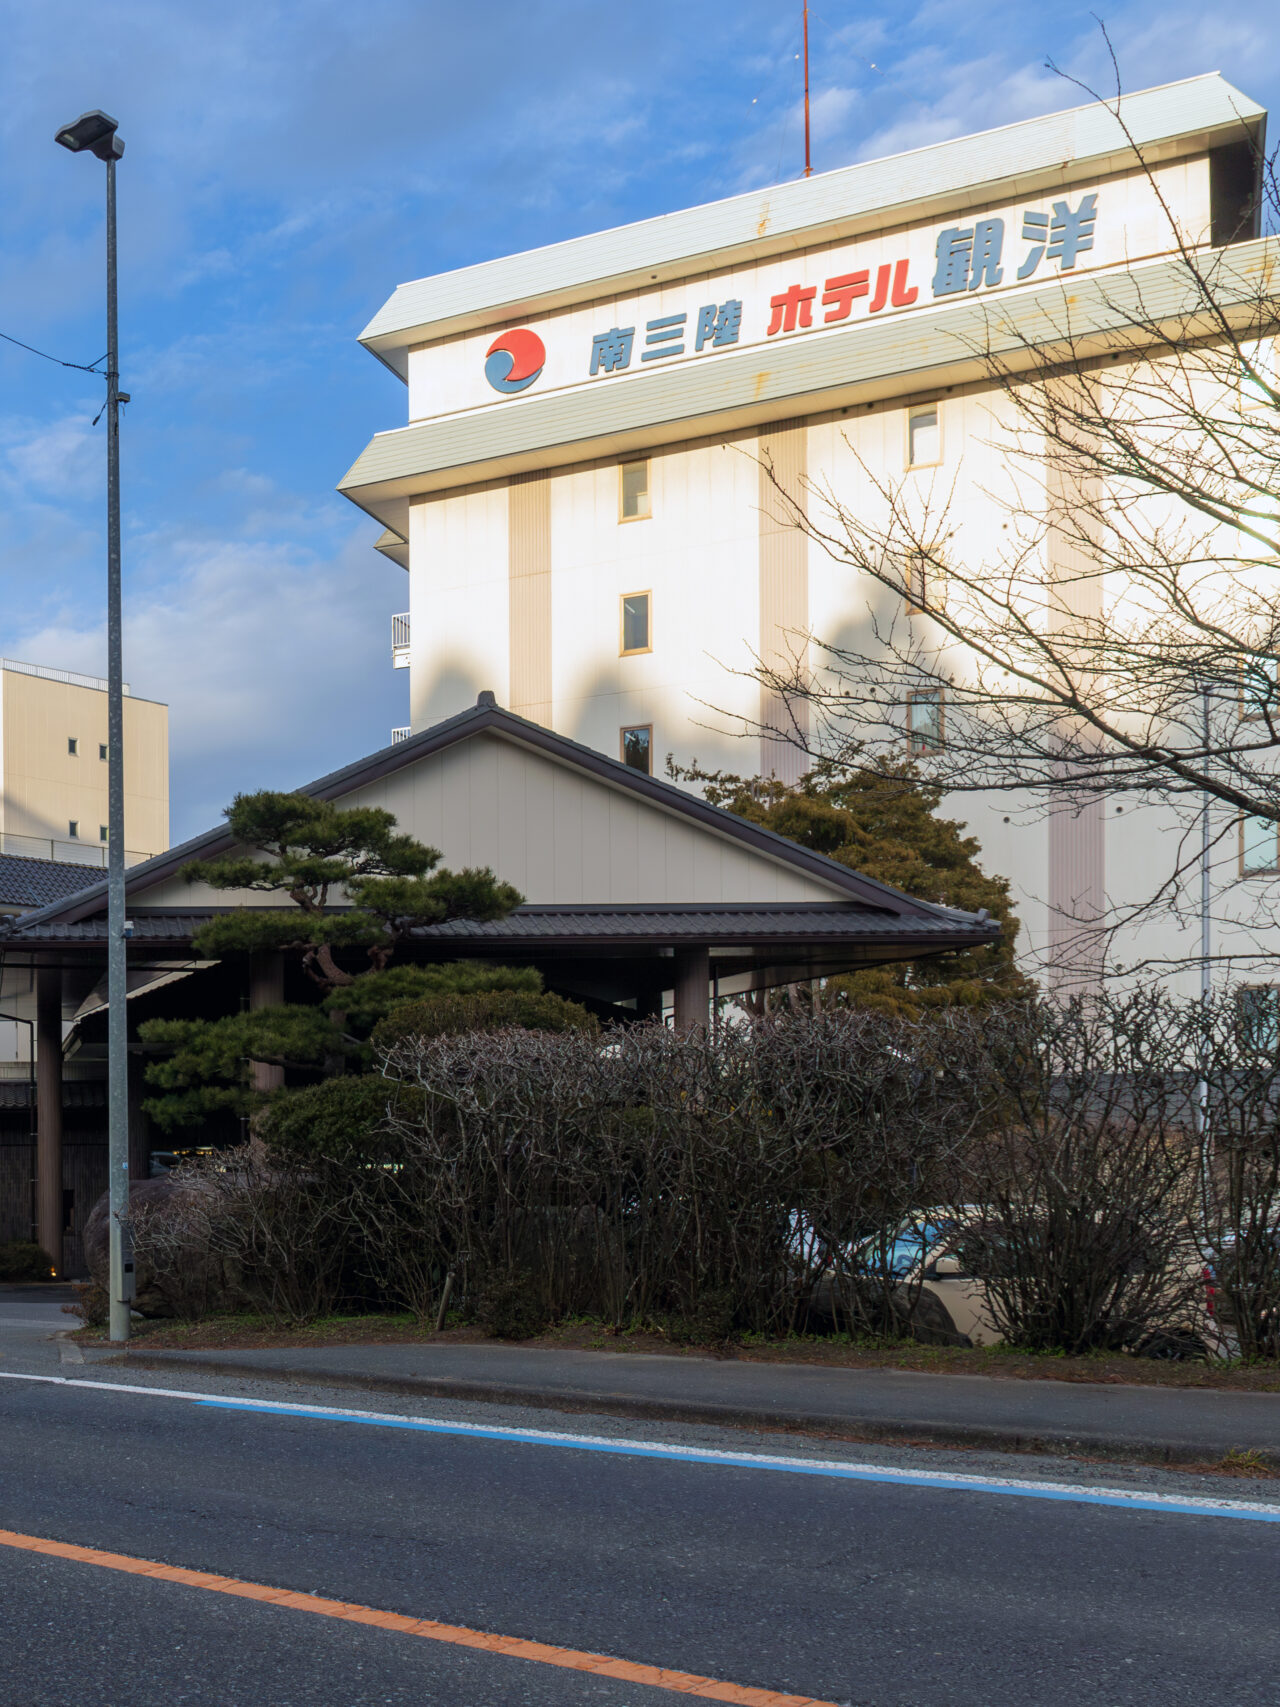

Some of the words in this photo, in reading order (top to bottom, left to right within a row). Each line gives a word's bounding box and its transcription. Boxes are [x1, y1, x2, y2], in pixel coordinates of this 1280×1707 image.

[589, 193, 1098, 376] 南三陸ホテル観洋
